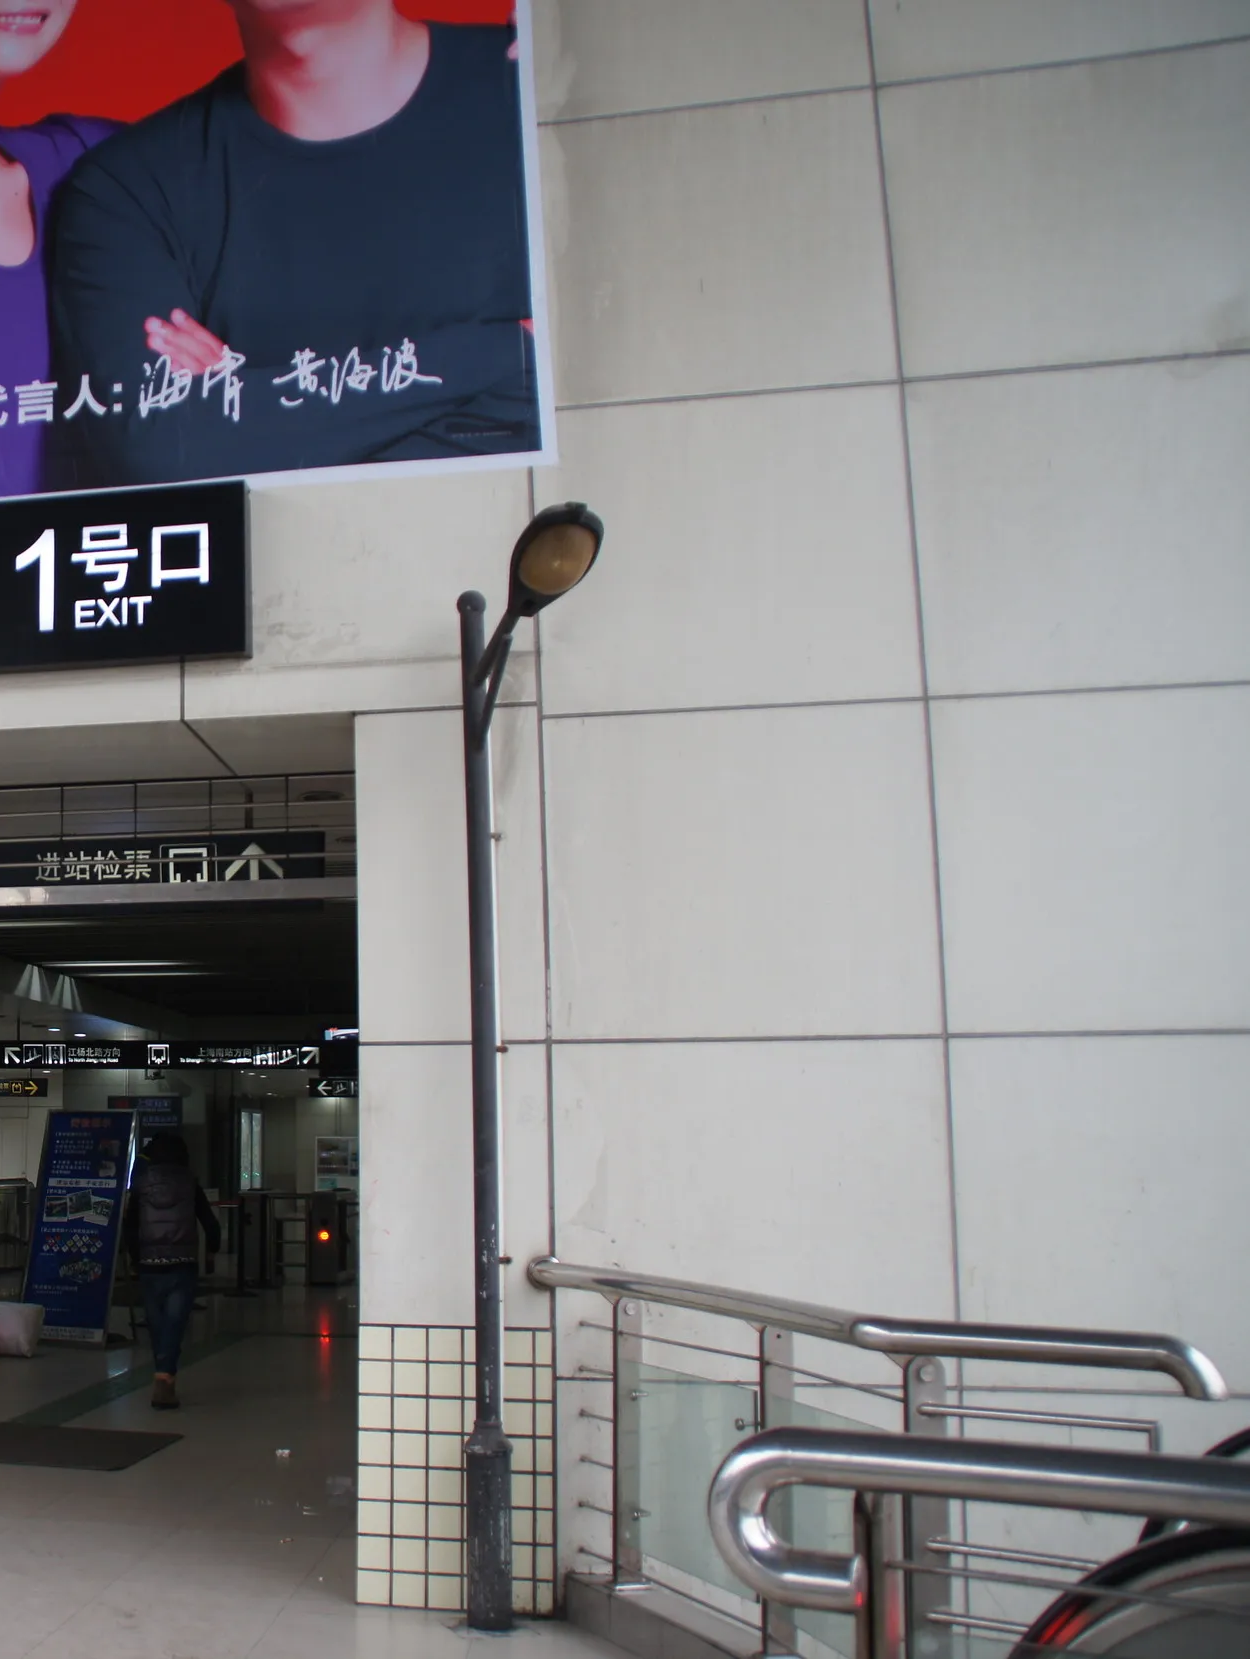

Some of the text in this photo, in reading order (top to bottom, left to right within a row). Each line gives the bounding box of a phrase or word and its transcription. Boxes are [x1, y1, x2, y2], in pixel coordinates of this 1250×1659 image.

[74, 595, 153, 630] EXIT
[35, 848, 152, 882] 进站检票
[67, 1047, 121, 1057] 江杨北路方向
